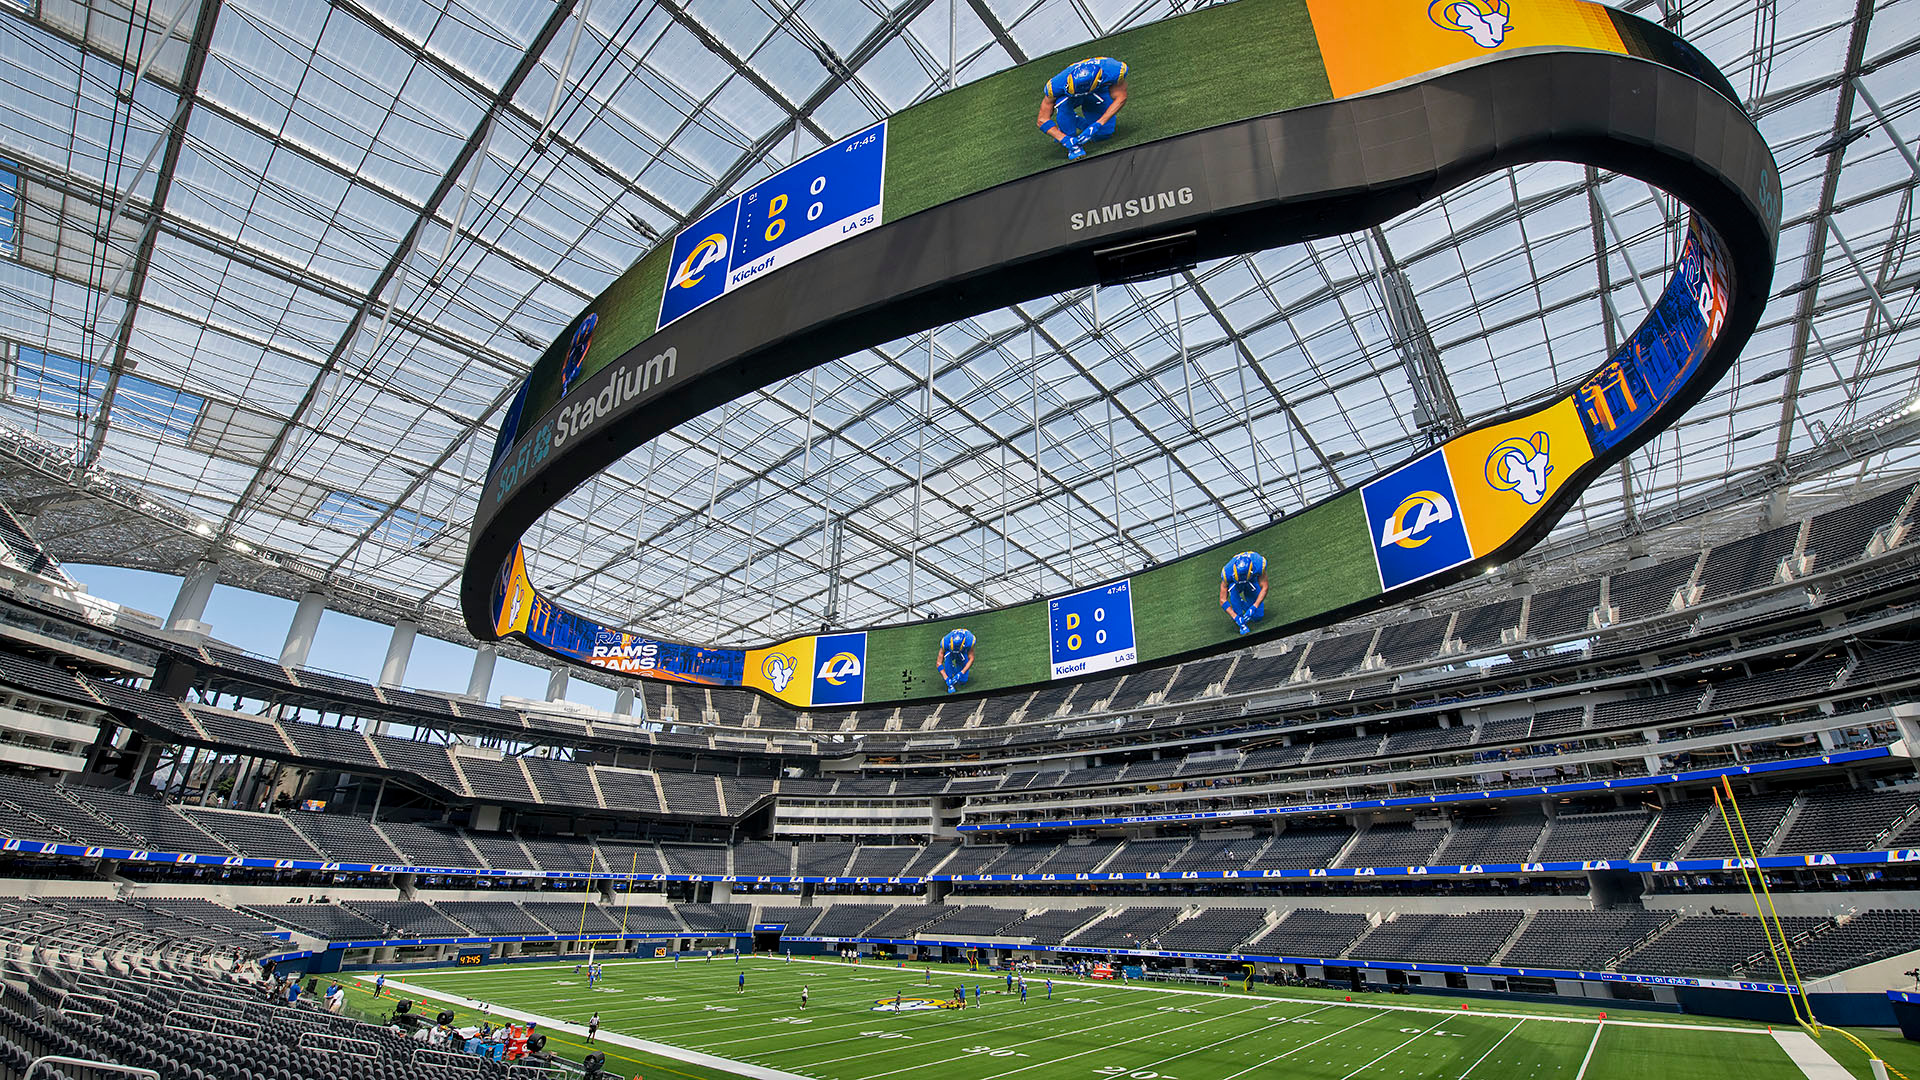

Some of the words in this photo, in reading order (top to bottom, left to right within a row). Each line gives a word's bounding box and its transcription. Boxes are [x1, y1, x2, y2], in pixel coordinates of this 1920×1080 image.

[846, 134, 876, 152] 47:45
[768, 194, 788, 218] D
[810, 176, 826, 195] 0
[807, 202, 823, 221] 0
[1070, 186, 1194, 230] SAMSUNG
[732, 256, 774, 285] Kickoff
[842, 221, 857, 234] LA
[859, 215, 874, 227] 35
[669, 234, 728, 290] LA
[497, 439, 532, 502] SoFi
[554, 346, 678, 448] Stadium
[1381, 490, 1452, 548] LA
[1107, 585, 1126, 595] 47:45
[1067, 613, 1080, 630] D
[1094, 608, 1105, 622] 0
[1096, 630, 1107, 644] 0
[592, 645, 658, 657] RAMS
[816, 652, 860, 685] LA
[1056, 662, 1086, 674] Kickoff
[1115, 654, 1124, 663] LA
[1126, 653, 1135, 661] 35
[3, 839, 21, 851] LA
[40, 842, 58, 854] LA
[84, 847, 104, 858] LA
[128, 850, 149, 860] LA
[176, 853, 197, 863] LA
[1887, 850, 1920, 862] LA
[223, 856, 243, 866] LA
[274, 859, 294, 868] LA
[1582, 860, 1610, 870] LA
[1722, 858, 1754, 869] LA
[1804, 854, 1836, 866] LA
[320, 862, 340, 870] LA
[1354, 867, 1375, 876] LA
[1407, 866, 1427, 875] LA
[1459, 864, 1483, 874] LA
[1521, 863, 1545, 872] LA
[1652, 861, 1680, 872] LA
[1108, 872, 1123, 880] LA
[1182, 871, 1198, 879] LA
[1223, 870, 1238, 878] LA
[1262, 869, 1281, 878] LA
[1309, 868, 1327, 877] LA
[460, 955, 480, 964] 47:45
